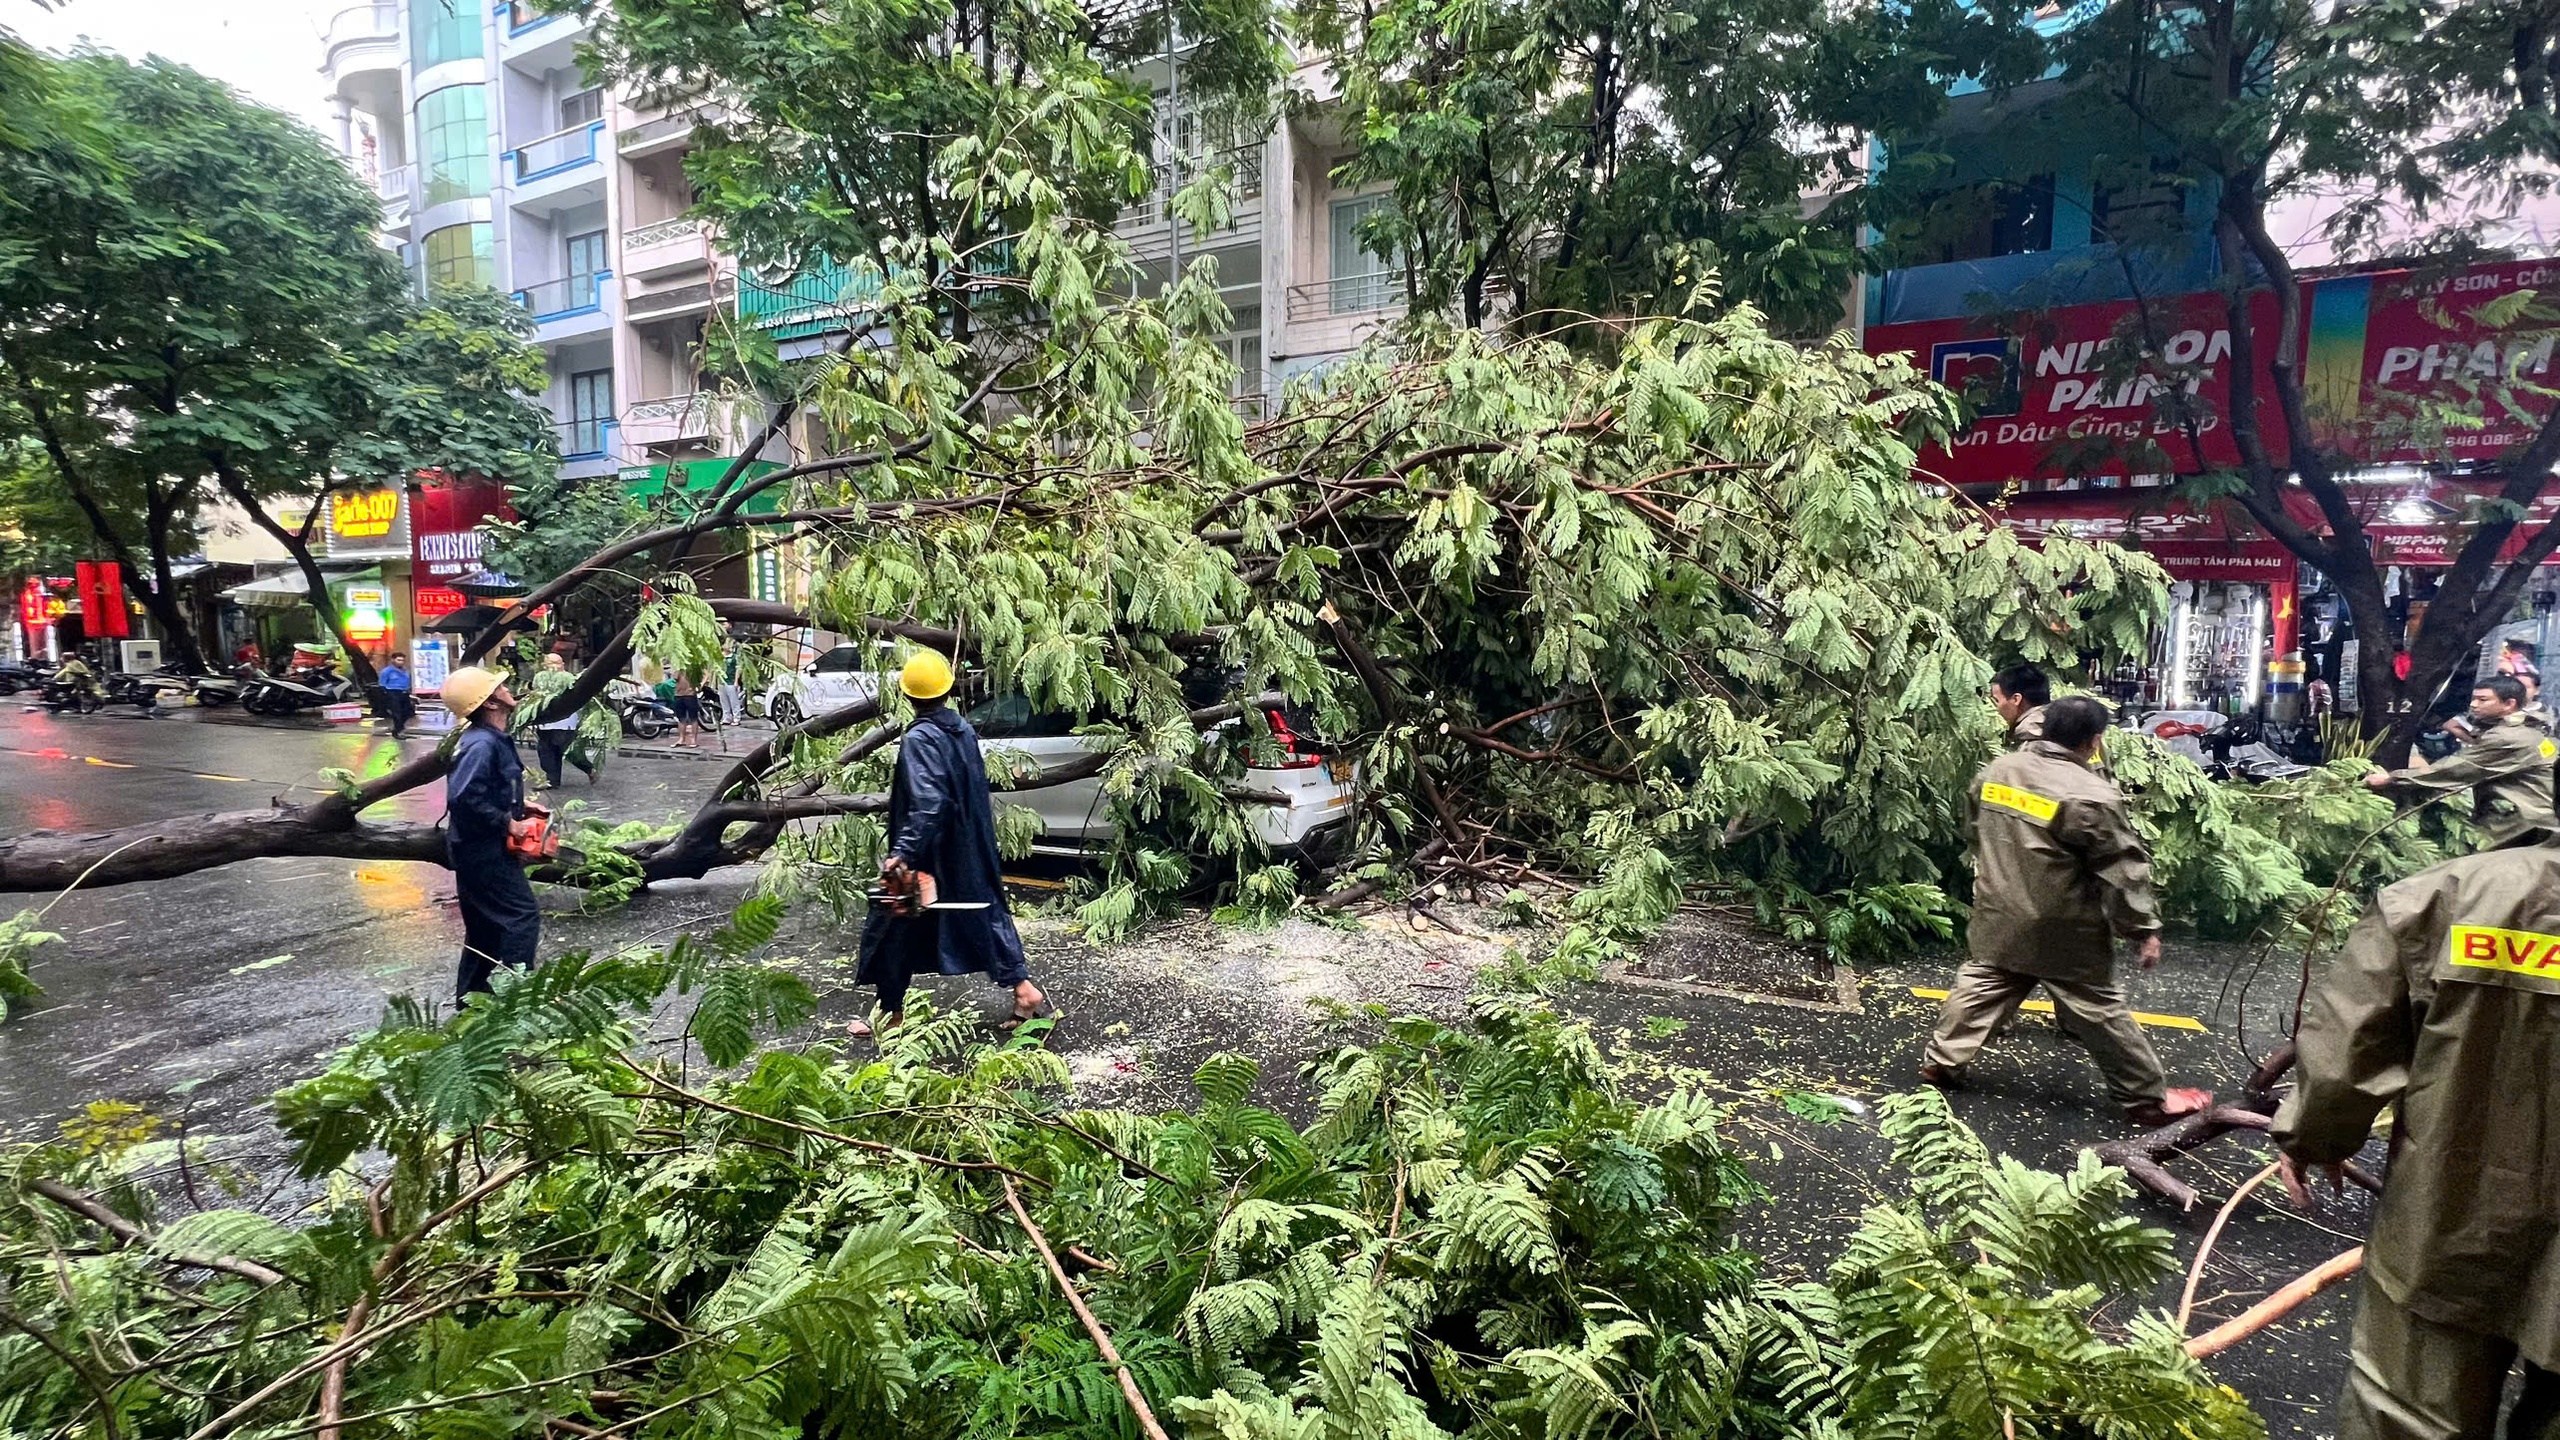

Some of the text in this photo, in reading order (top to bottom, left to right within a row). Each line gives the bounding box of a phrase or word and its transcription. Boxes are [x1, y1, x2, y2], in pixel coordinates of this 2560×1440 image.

[2383, 534, 2448, 546] NIPPON
[2163, 555, 2282, 567] TRUNG TÂM PHA MÀU
